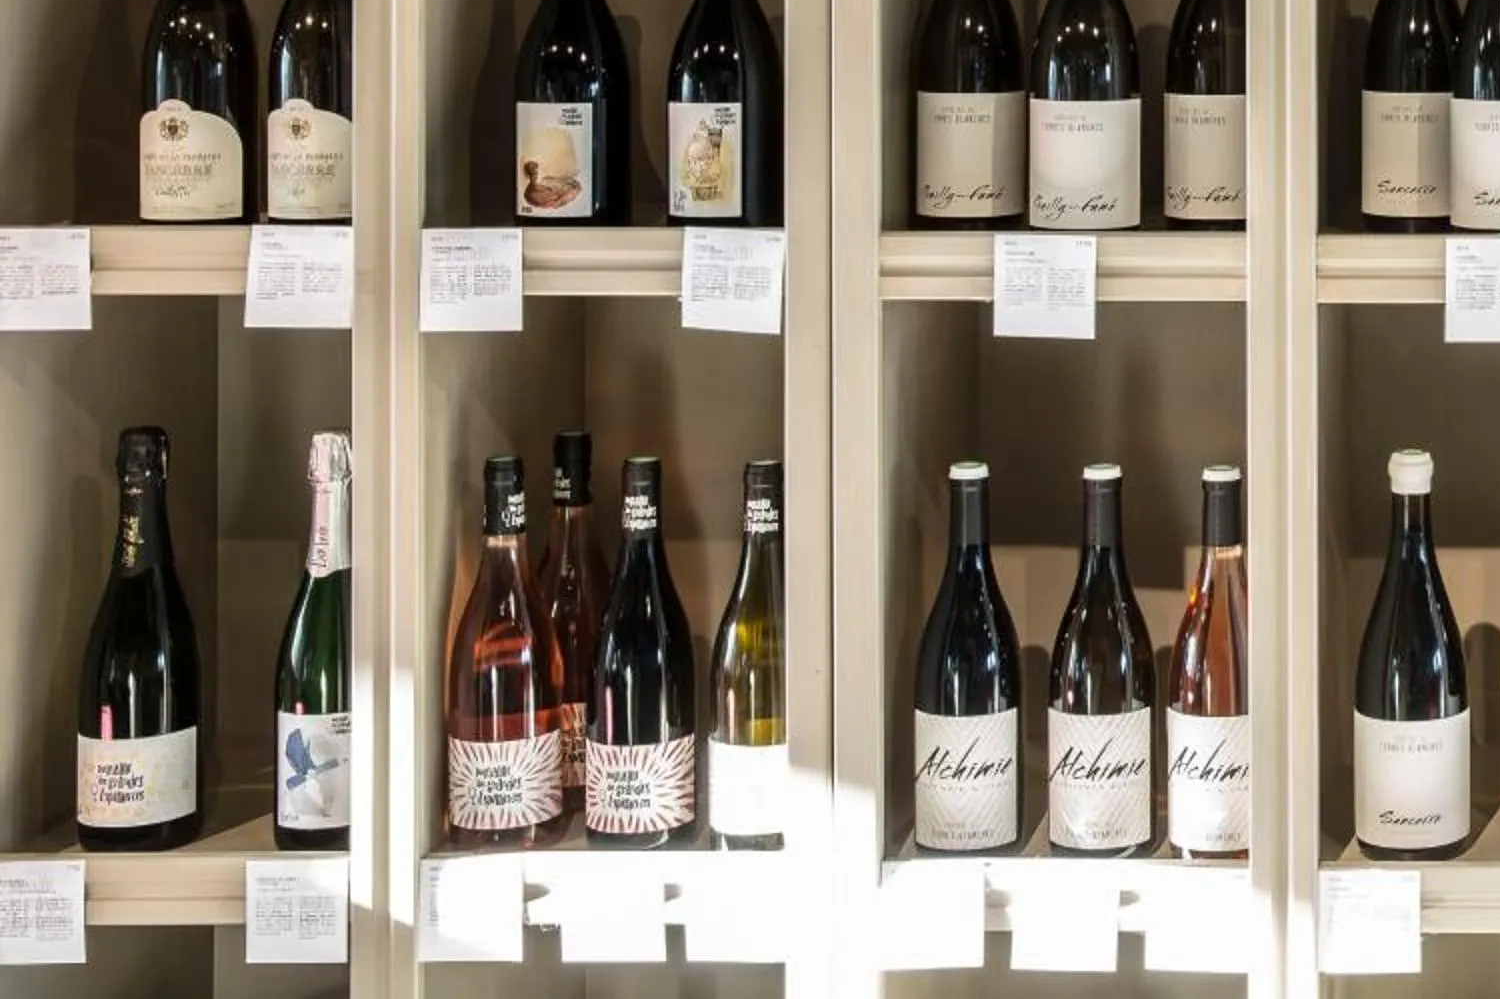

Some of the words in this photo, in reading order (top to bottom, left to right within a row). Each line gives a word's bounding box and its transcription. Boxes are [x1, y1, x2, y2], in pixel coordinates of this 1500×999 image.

[914, 737, 1013, 783] Alchimie
[1050, 738, 1147, 782] Alchimie
[1168, 738, 1249, 781] Alchimi
